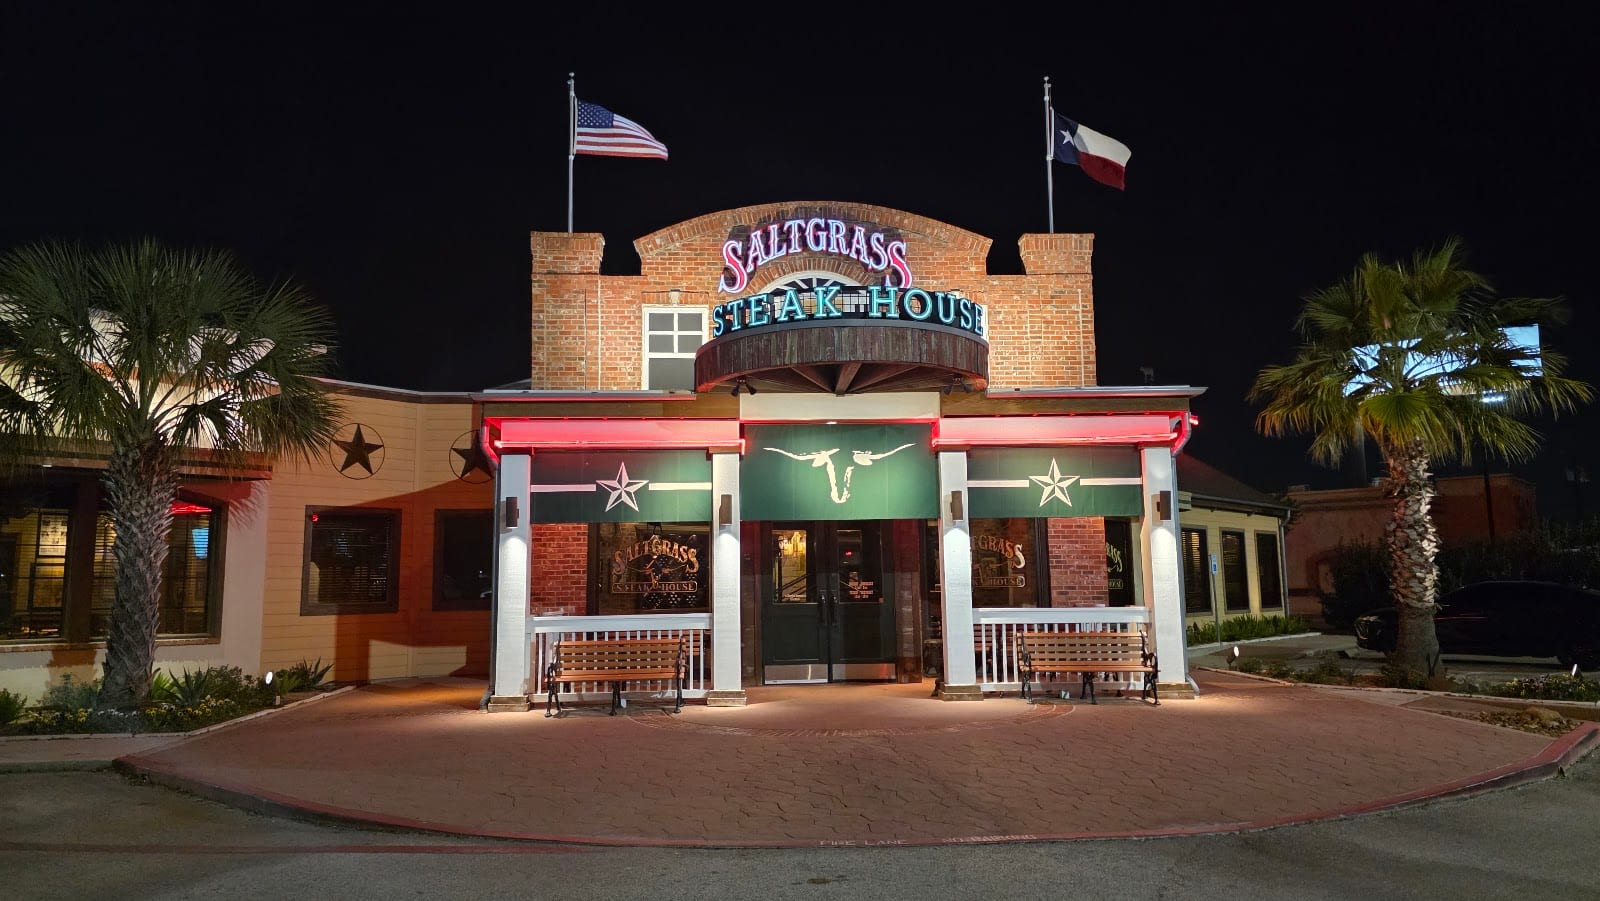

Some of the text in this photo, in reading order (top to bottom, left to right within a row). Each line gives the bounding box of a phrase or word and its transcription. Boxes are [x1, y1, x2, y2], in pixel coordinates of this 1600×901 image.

[717, 217, 913, 293] SALTGRASS
[712, 285, 984, 337] STEAK HOUSE
[612, 538, 699, 574] SALTGRASS
[661, 583, 695, 591] HOUSE
